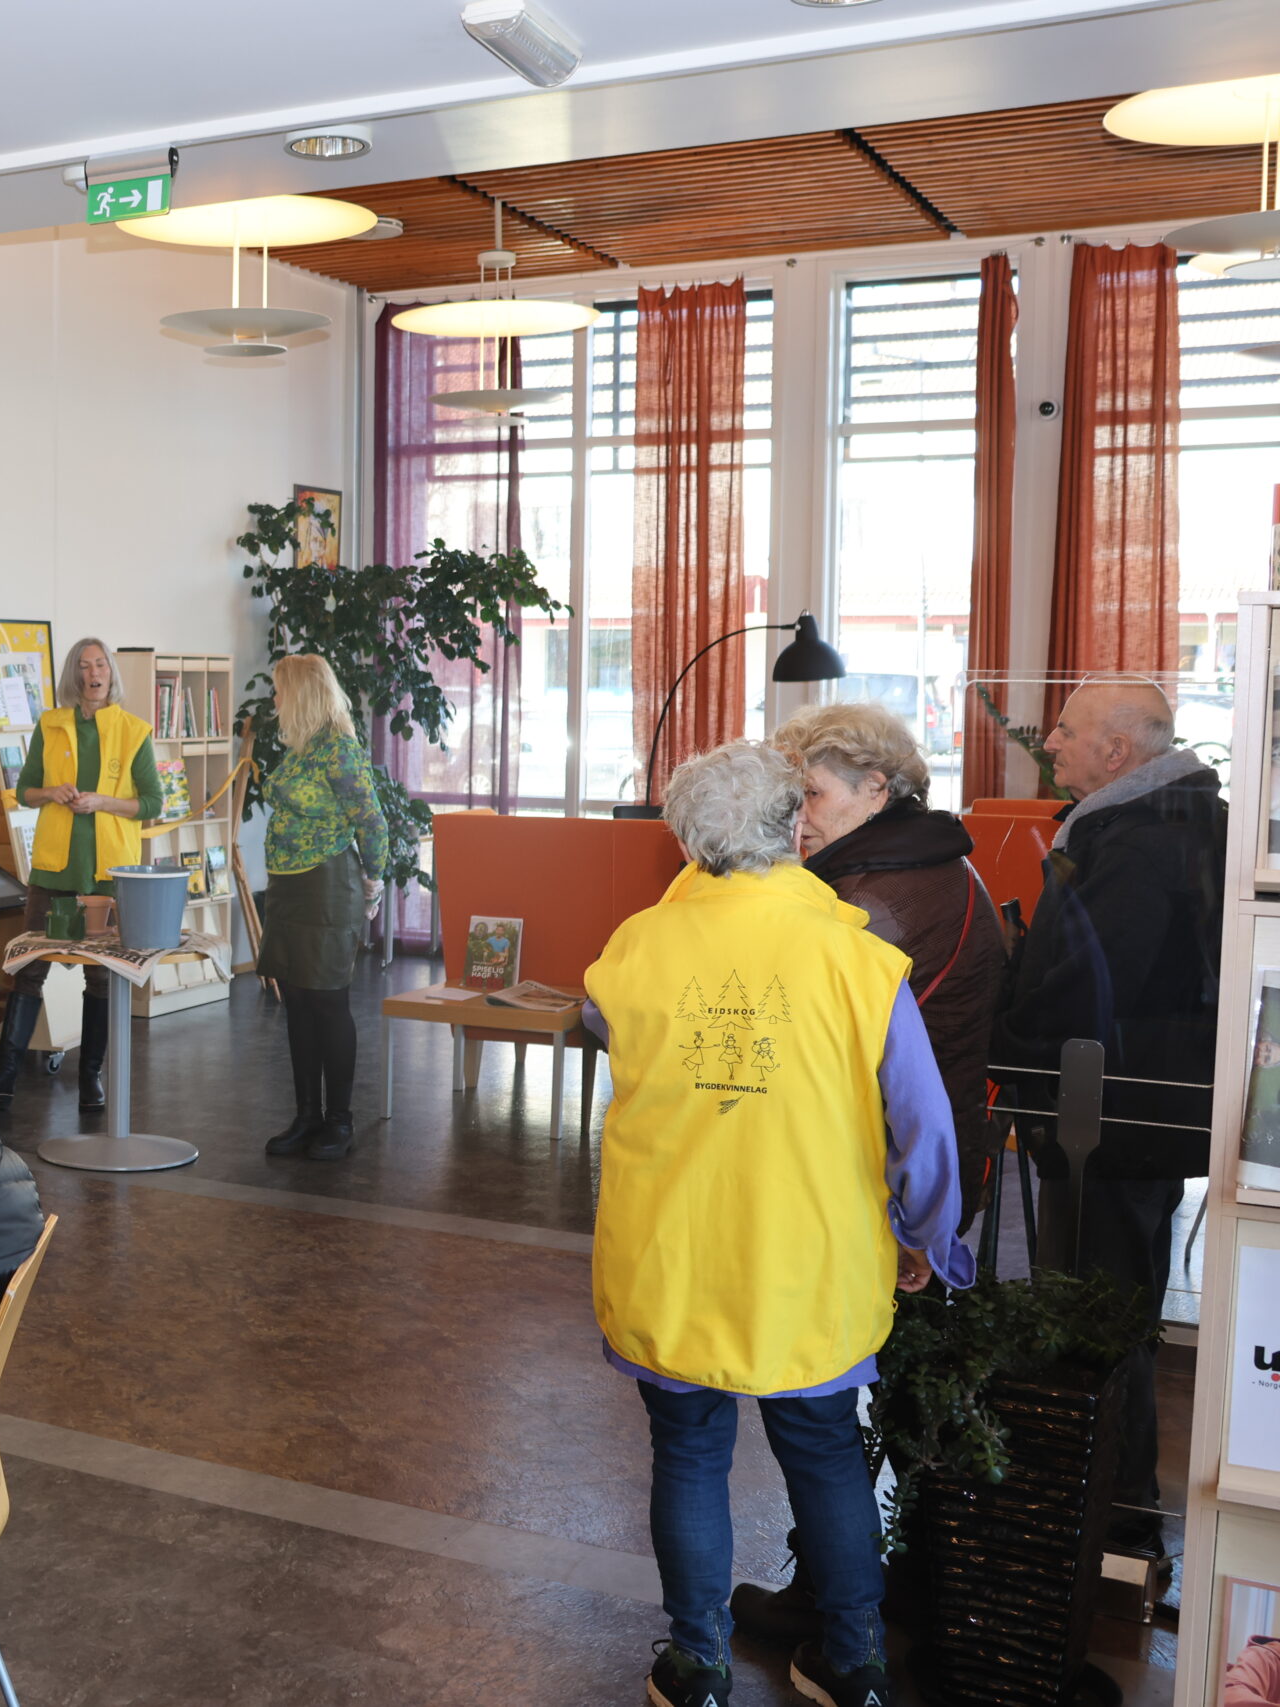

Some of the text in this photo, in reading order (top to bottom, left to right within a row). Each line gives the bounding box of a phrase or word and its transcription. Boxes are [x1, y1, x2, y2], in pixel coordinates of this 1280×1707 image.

[472, 965, 505, 975] SPISELIG
[707, 1007, 756, 1016] EIDSKOG
[694, 1082, 768, 1094] BYGDEKVINNELAG
[1258, 1380, 1280, 1390] Norg
